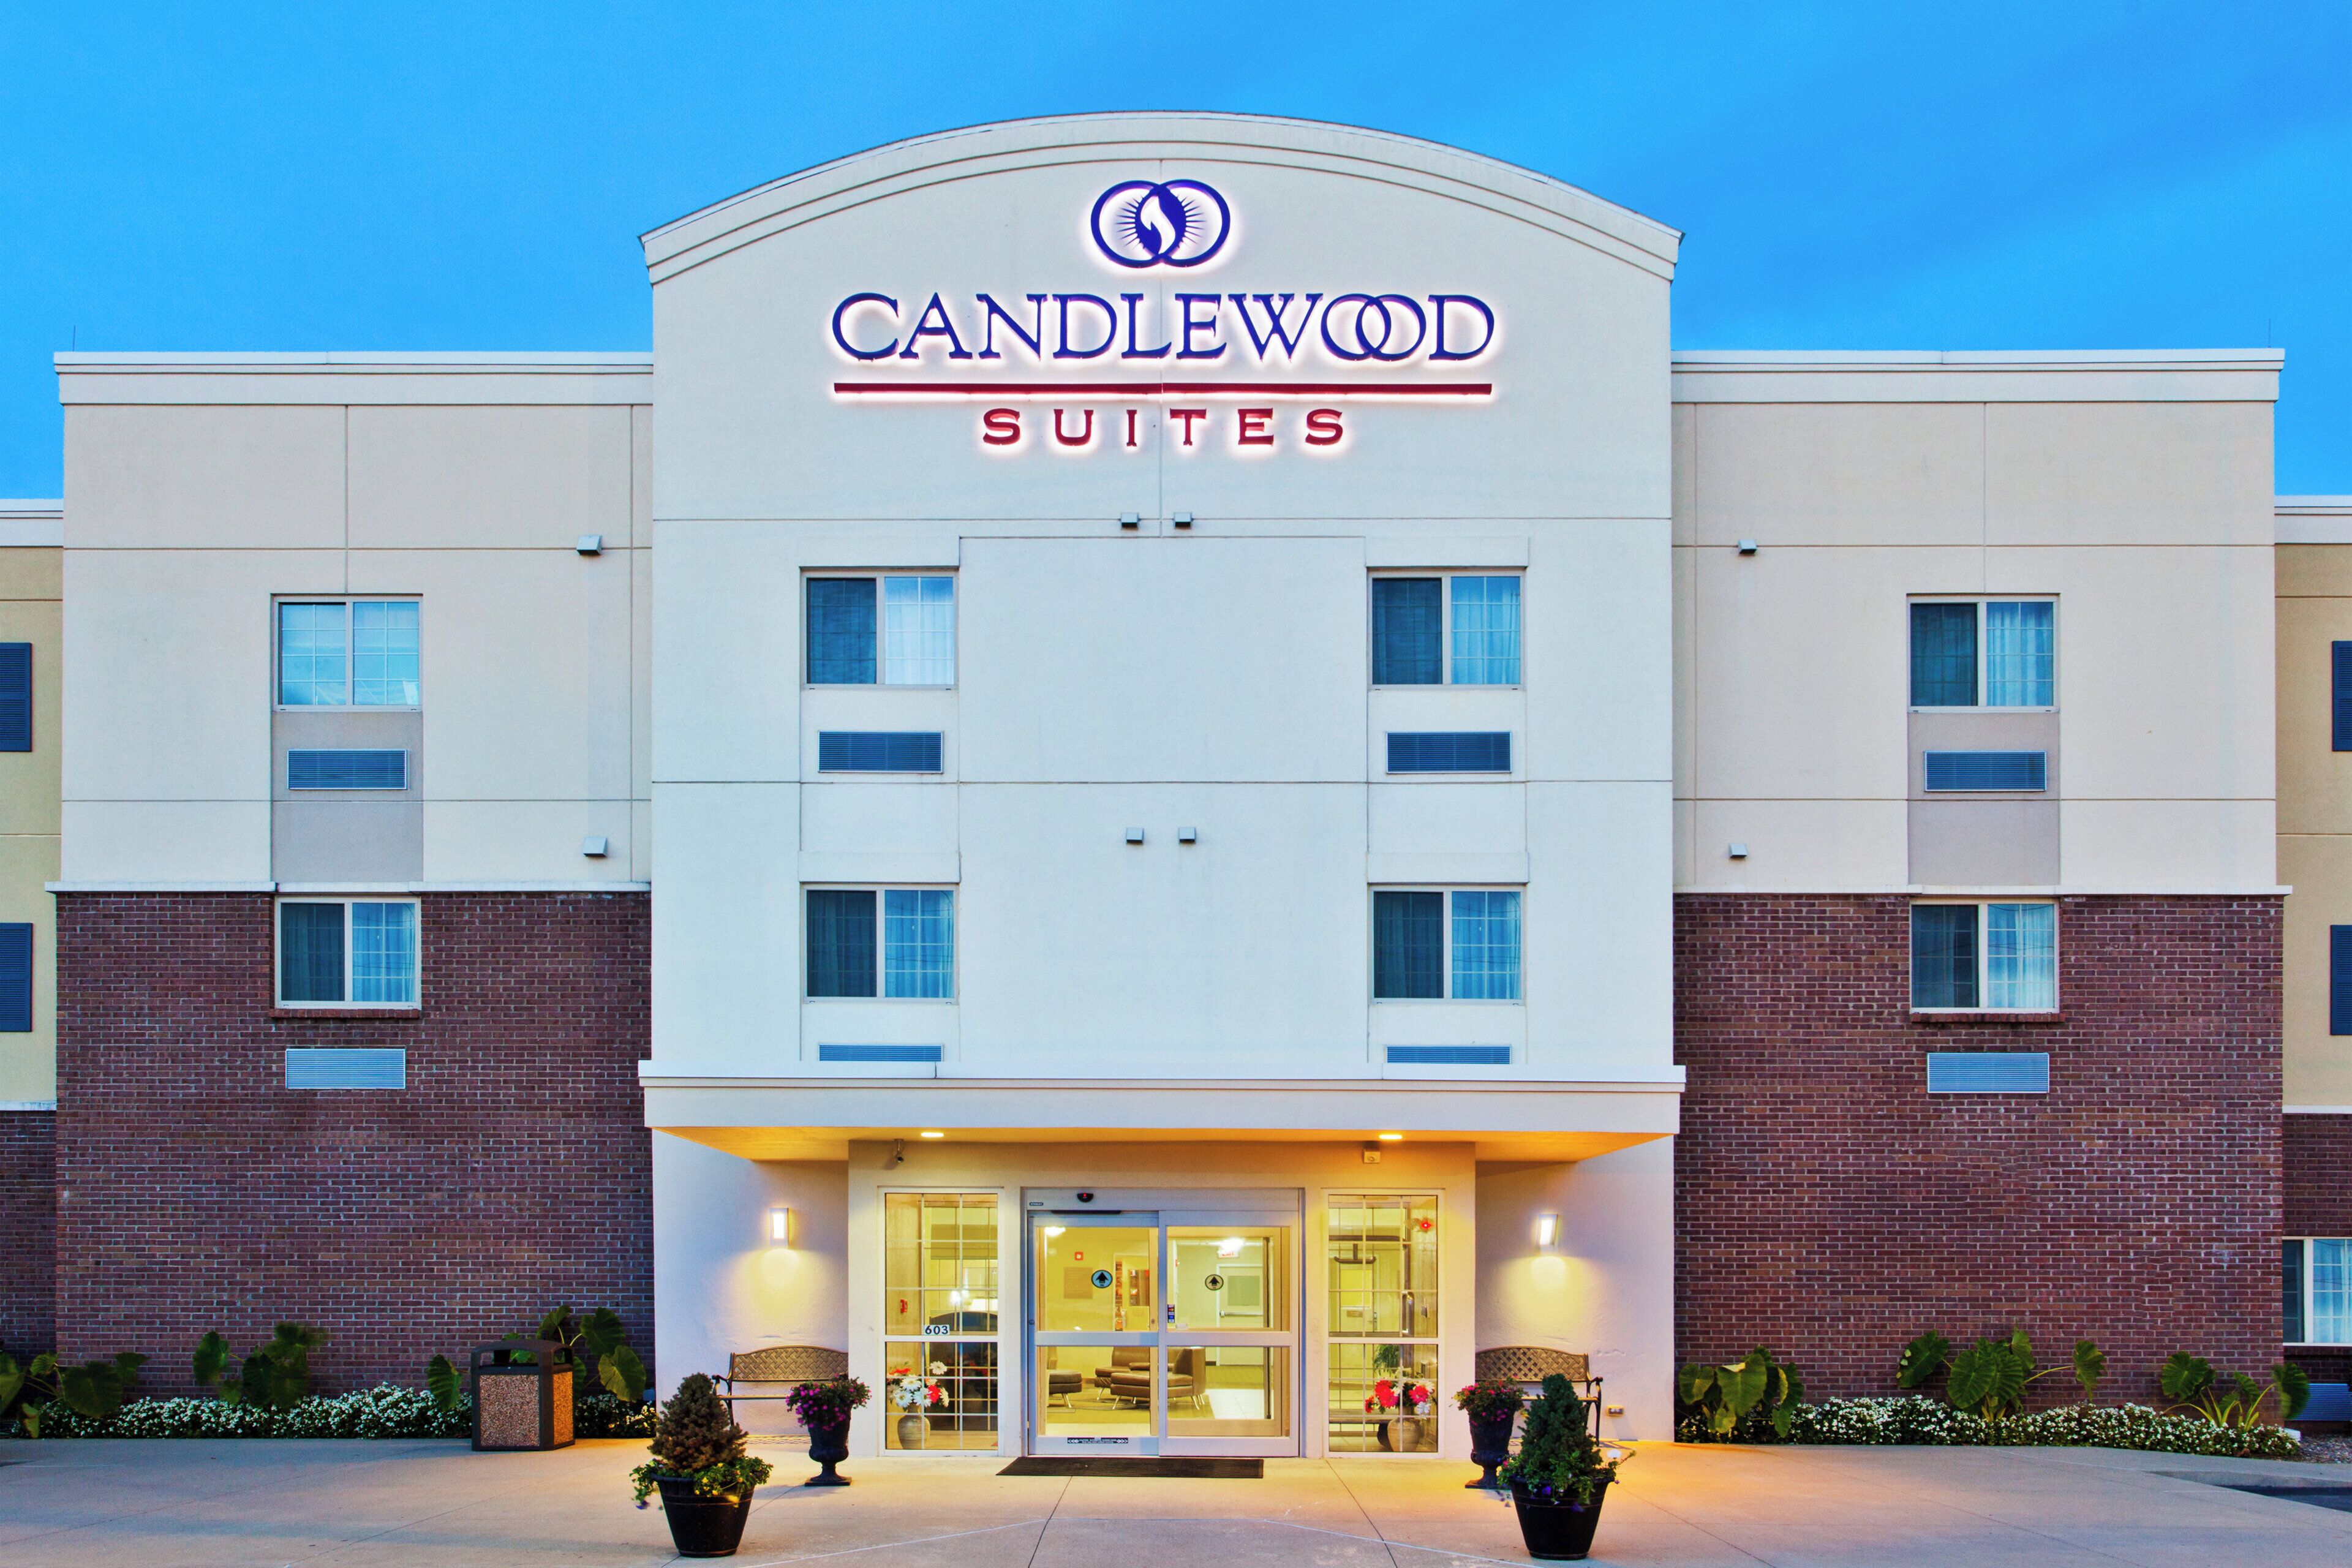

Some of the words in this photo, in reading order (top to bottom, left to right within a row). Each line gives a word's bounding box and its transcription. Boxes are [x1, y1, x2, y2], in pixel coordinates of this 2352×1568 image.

[832, 292, 1495, 361] CANDLEWOOD
[983, 408, 1343, 447] SUITES
[925, 1325, 948, 1335] 603
